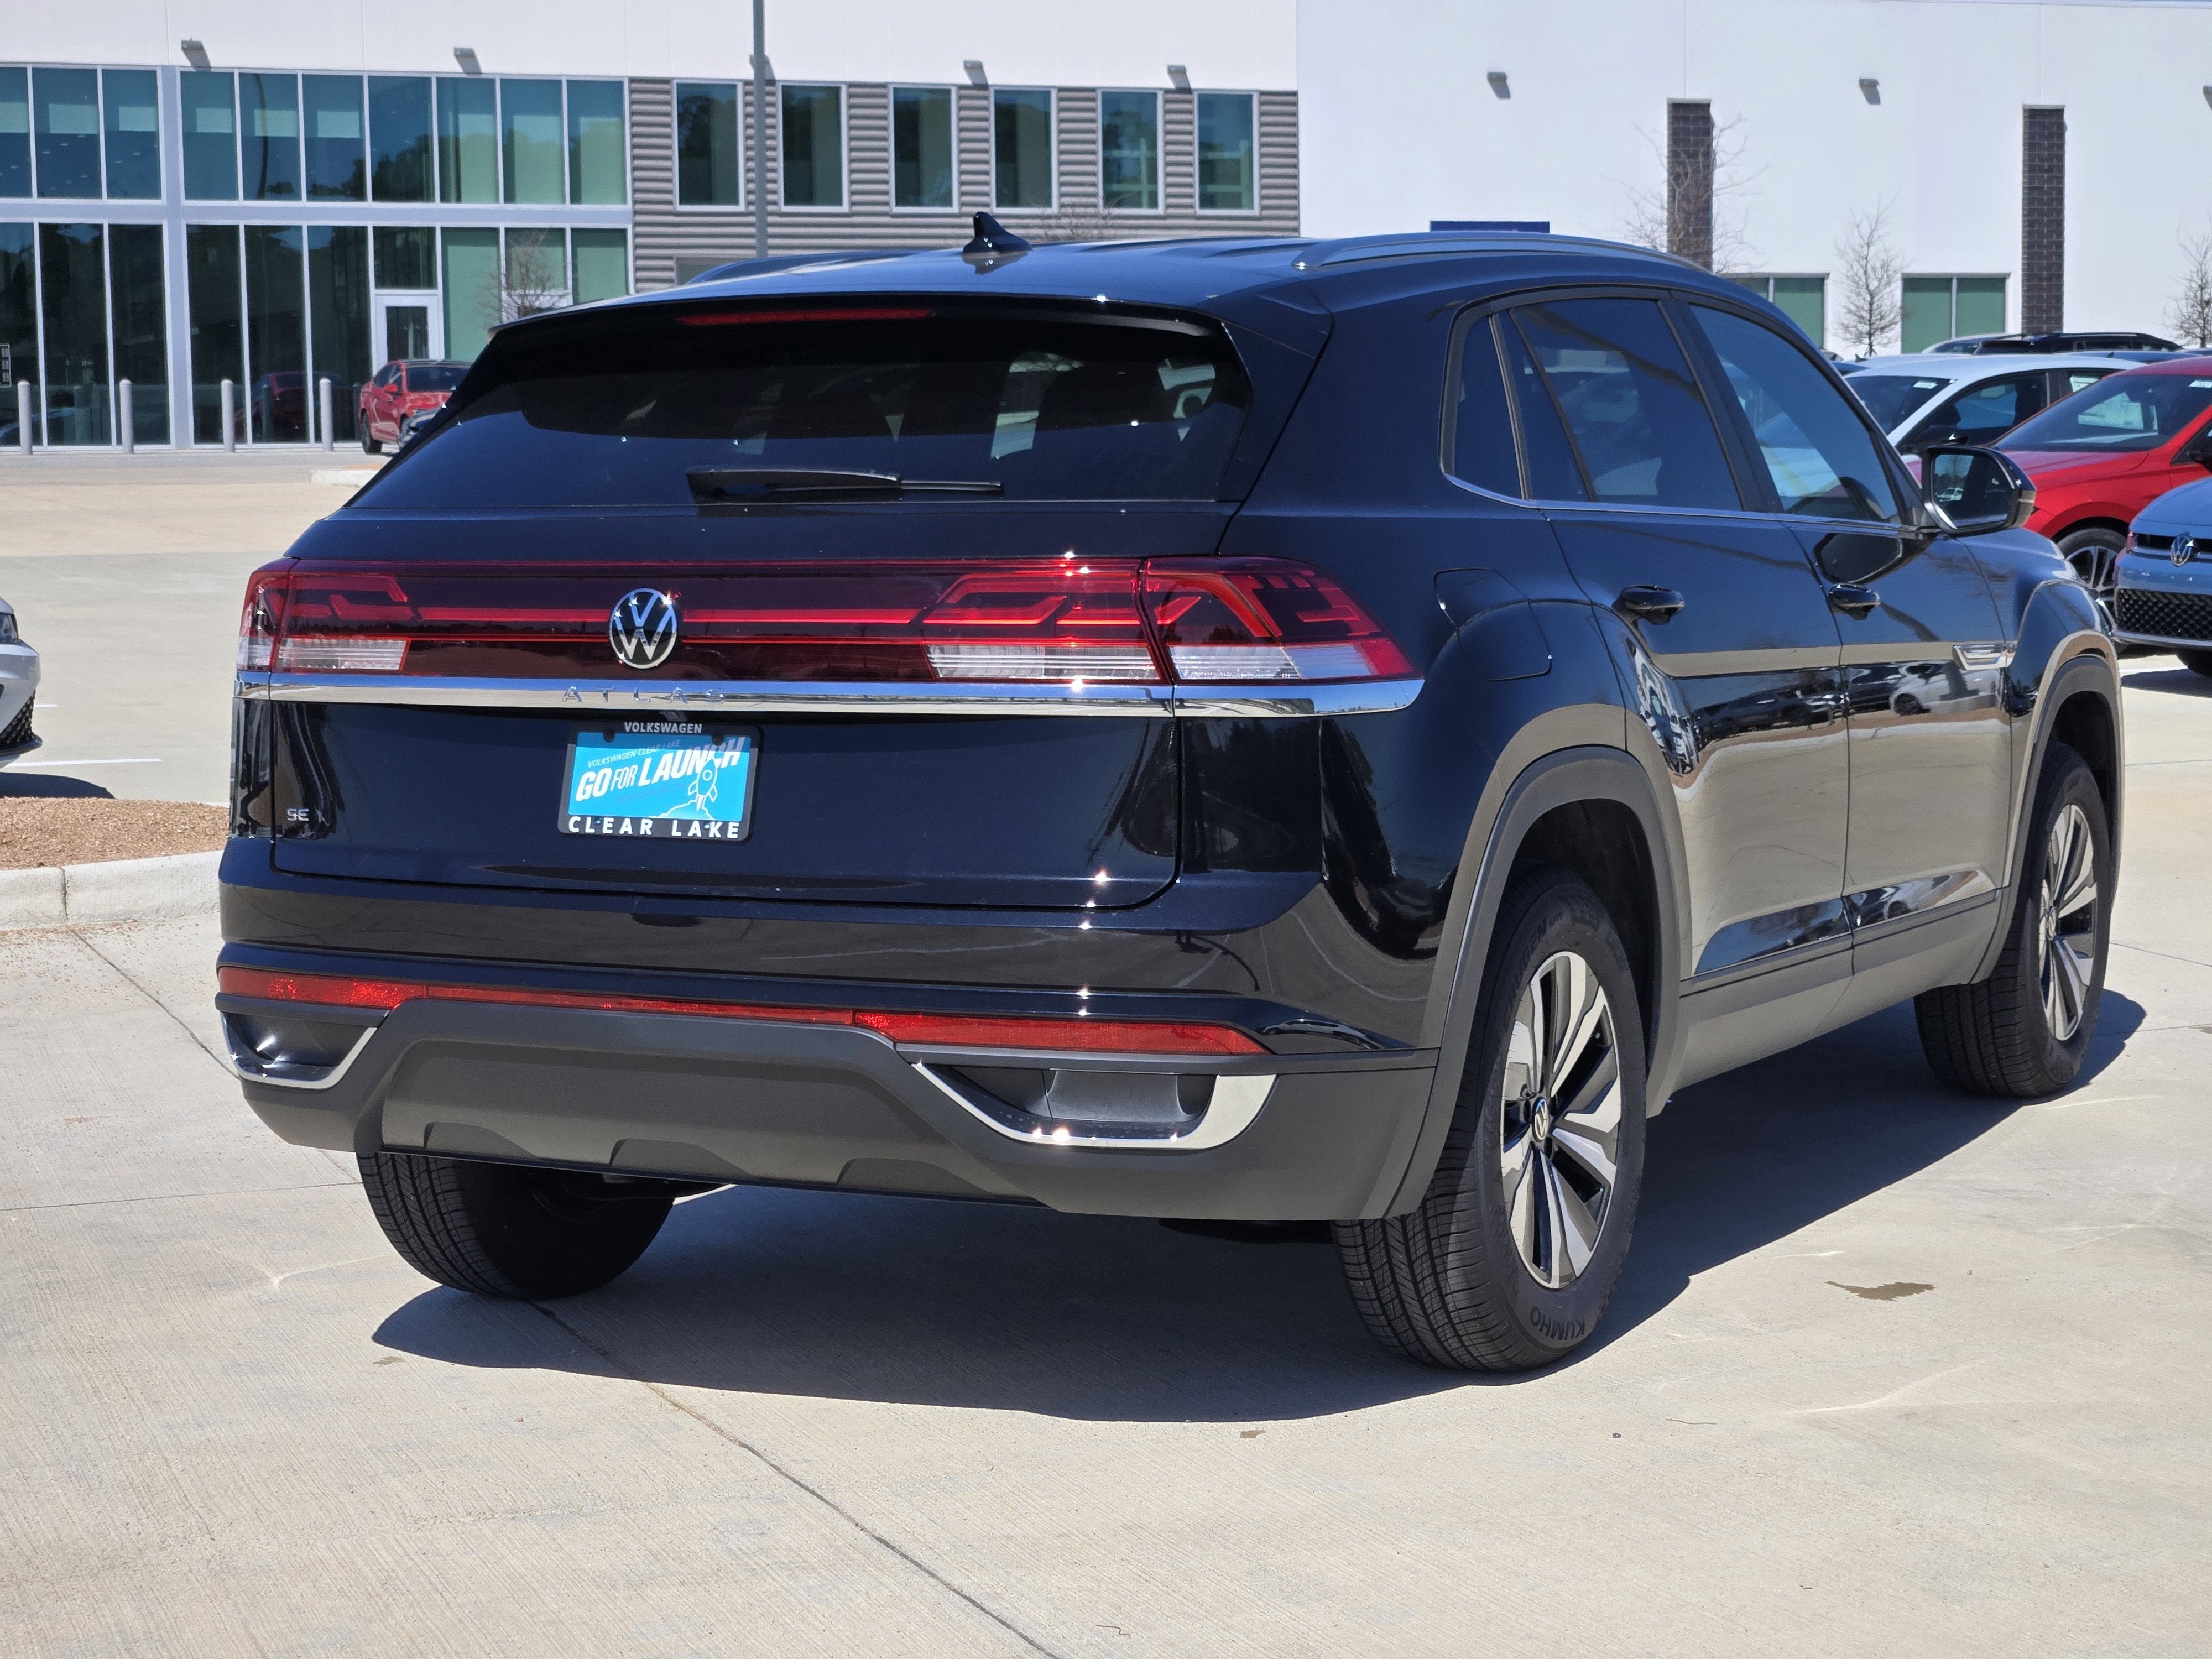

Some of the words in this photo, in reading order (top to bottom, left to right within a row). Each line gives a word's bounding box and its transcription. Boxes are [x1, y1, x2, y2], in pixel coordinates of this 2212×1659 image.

[609, 588, 677, 669] VW
[561, 686, 726, 704] ATLAS
[624, 722, 703, 734] VOLKSWAGEN
[588, 749, 637, 768] VOLKSWAGEN
[637, 744, 661, 756] CLEAR
[662, 739, 681, 750] LAKE
[576, 767, 613, 802] GO
[610, 765, 639, 791] FOR
[638, 737, 745, 787] LAUNCH
[287, 808, 309, 821] SE
[568, 816, 653, 836] CLEAR
[671, 820, 739, 838] LAKE
[1530, 1306, 1585, 1340] KUMHO
